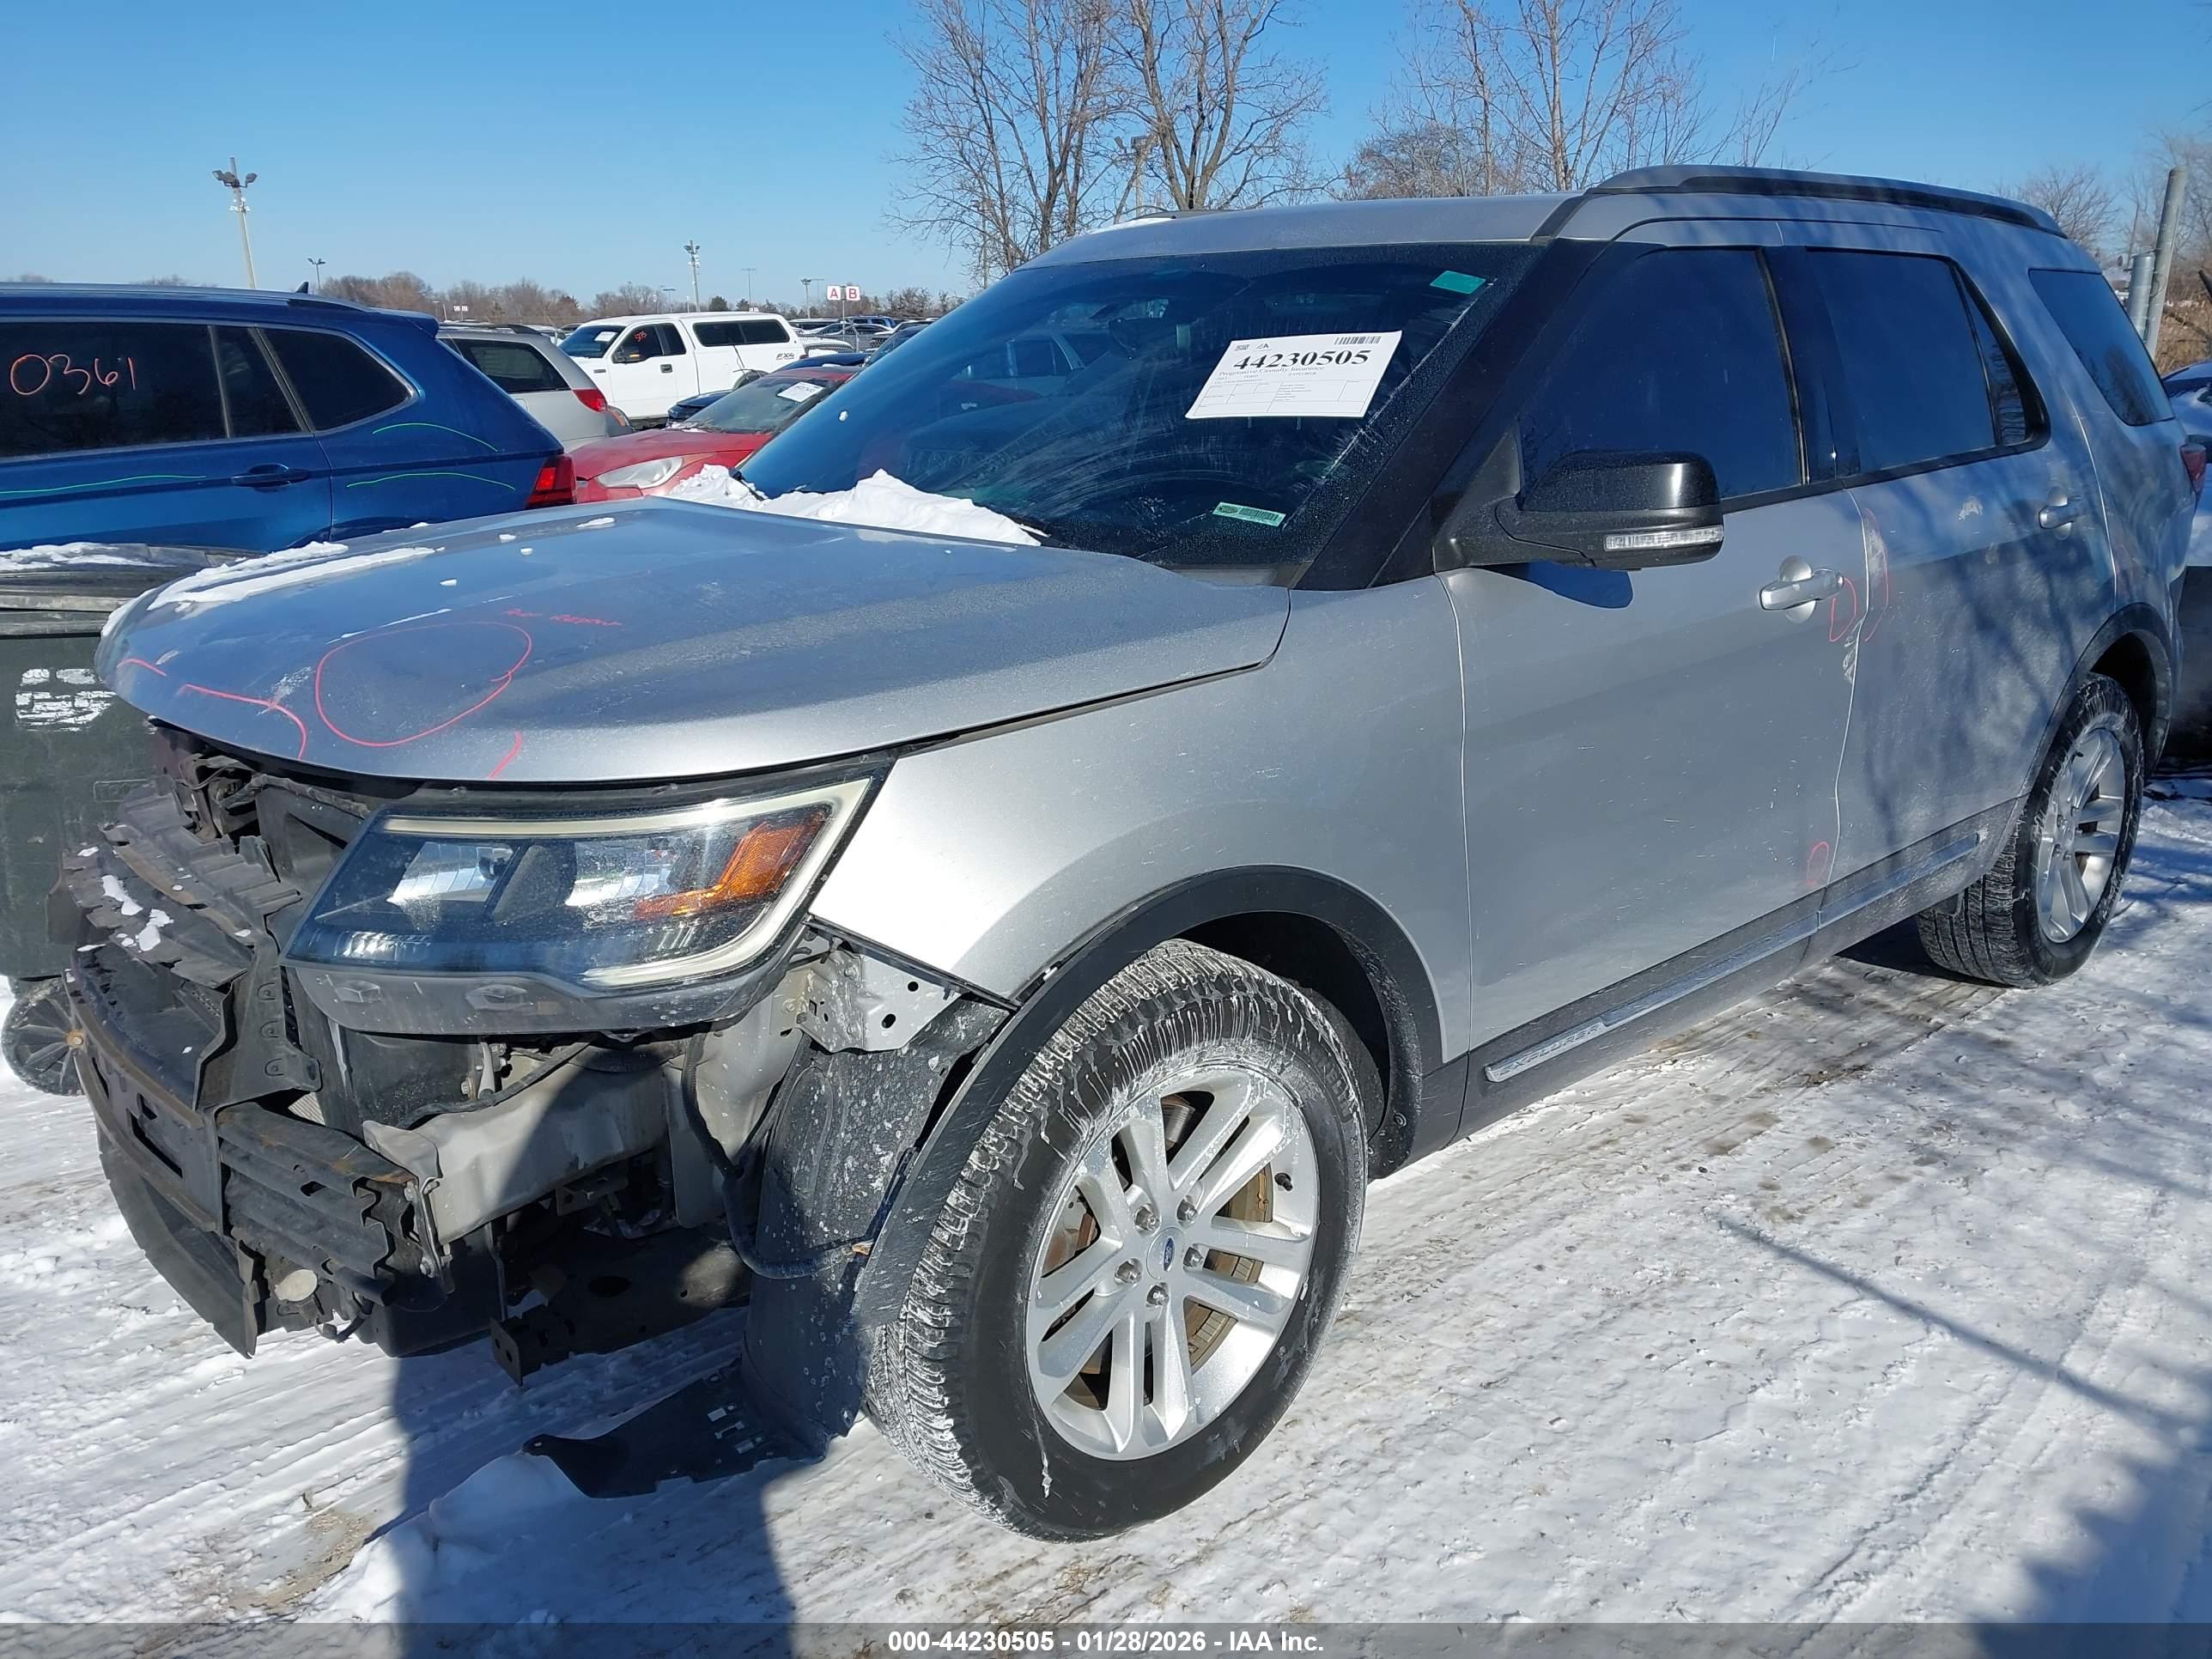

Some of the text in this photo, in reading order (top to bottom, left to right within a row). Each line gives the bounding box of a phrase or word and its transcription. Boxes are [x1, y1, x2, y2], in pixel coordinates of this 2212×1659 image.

[830, 288, 839, 299] A
[848, 288, 857, 299] B
[1234, 350, 1372, 369] 44230505
[9, 354, 136, 395] 0361
